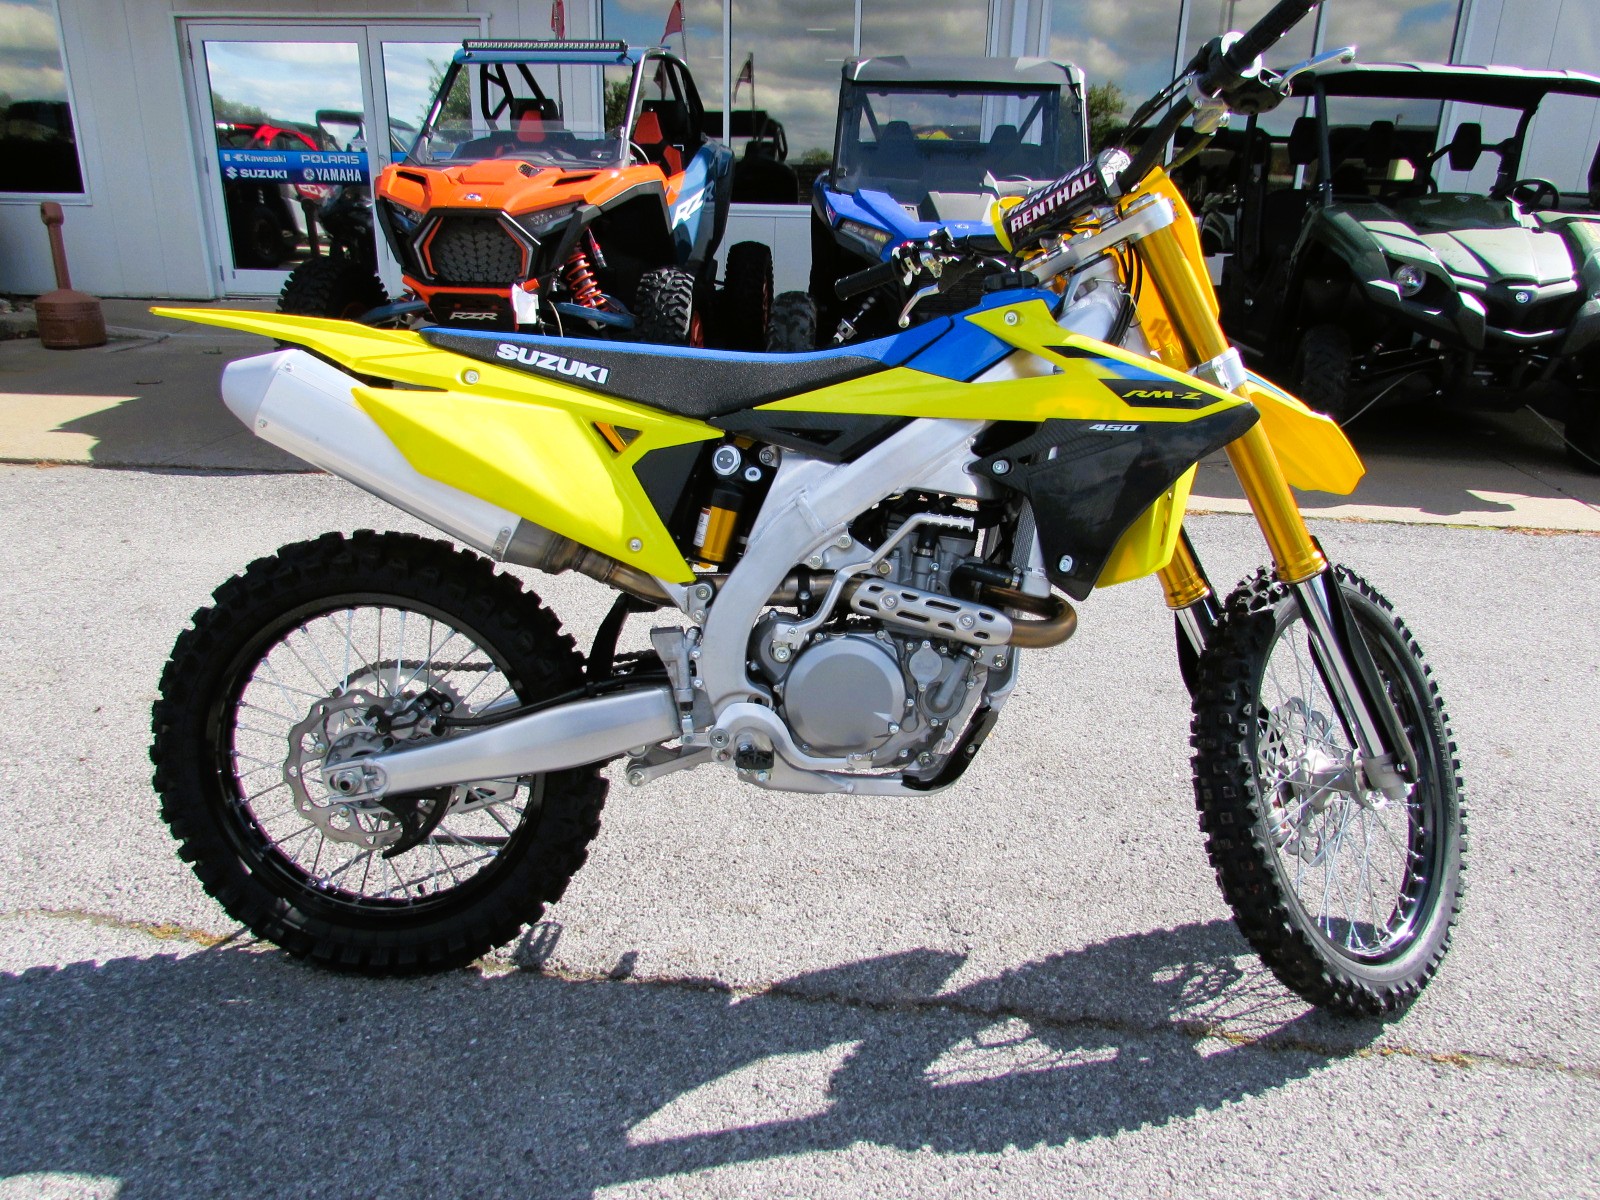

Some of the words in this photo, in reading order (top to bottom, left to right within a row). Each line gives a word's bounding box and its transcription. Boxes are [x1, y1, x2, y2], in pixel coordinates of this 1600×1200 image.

[243, 153, 287, 163] Kawasaki
[301, 154, 360, 165] POLARIS
[240, 168, 288, 179] SUZUKI
[316, 168, 362, 182] YAMAHA
[672, 180, 715, 230] RZR
[1010, 173, 1097, 233] RENTHAL
[449, 311, 498, 321] RZR
[496, 343, 609, 384] SUZUKI
[1122, 389, 1203, 400] RM-Z
[1088, 423, 1140, 432] 450
